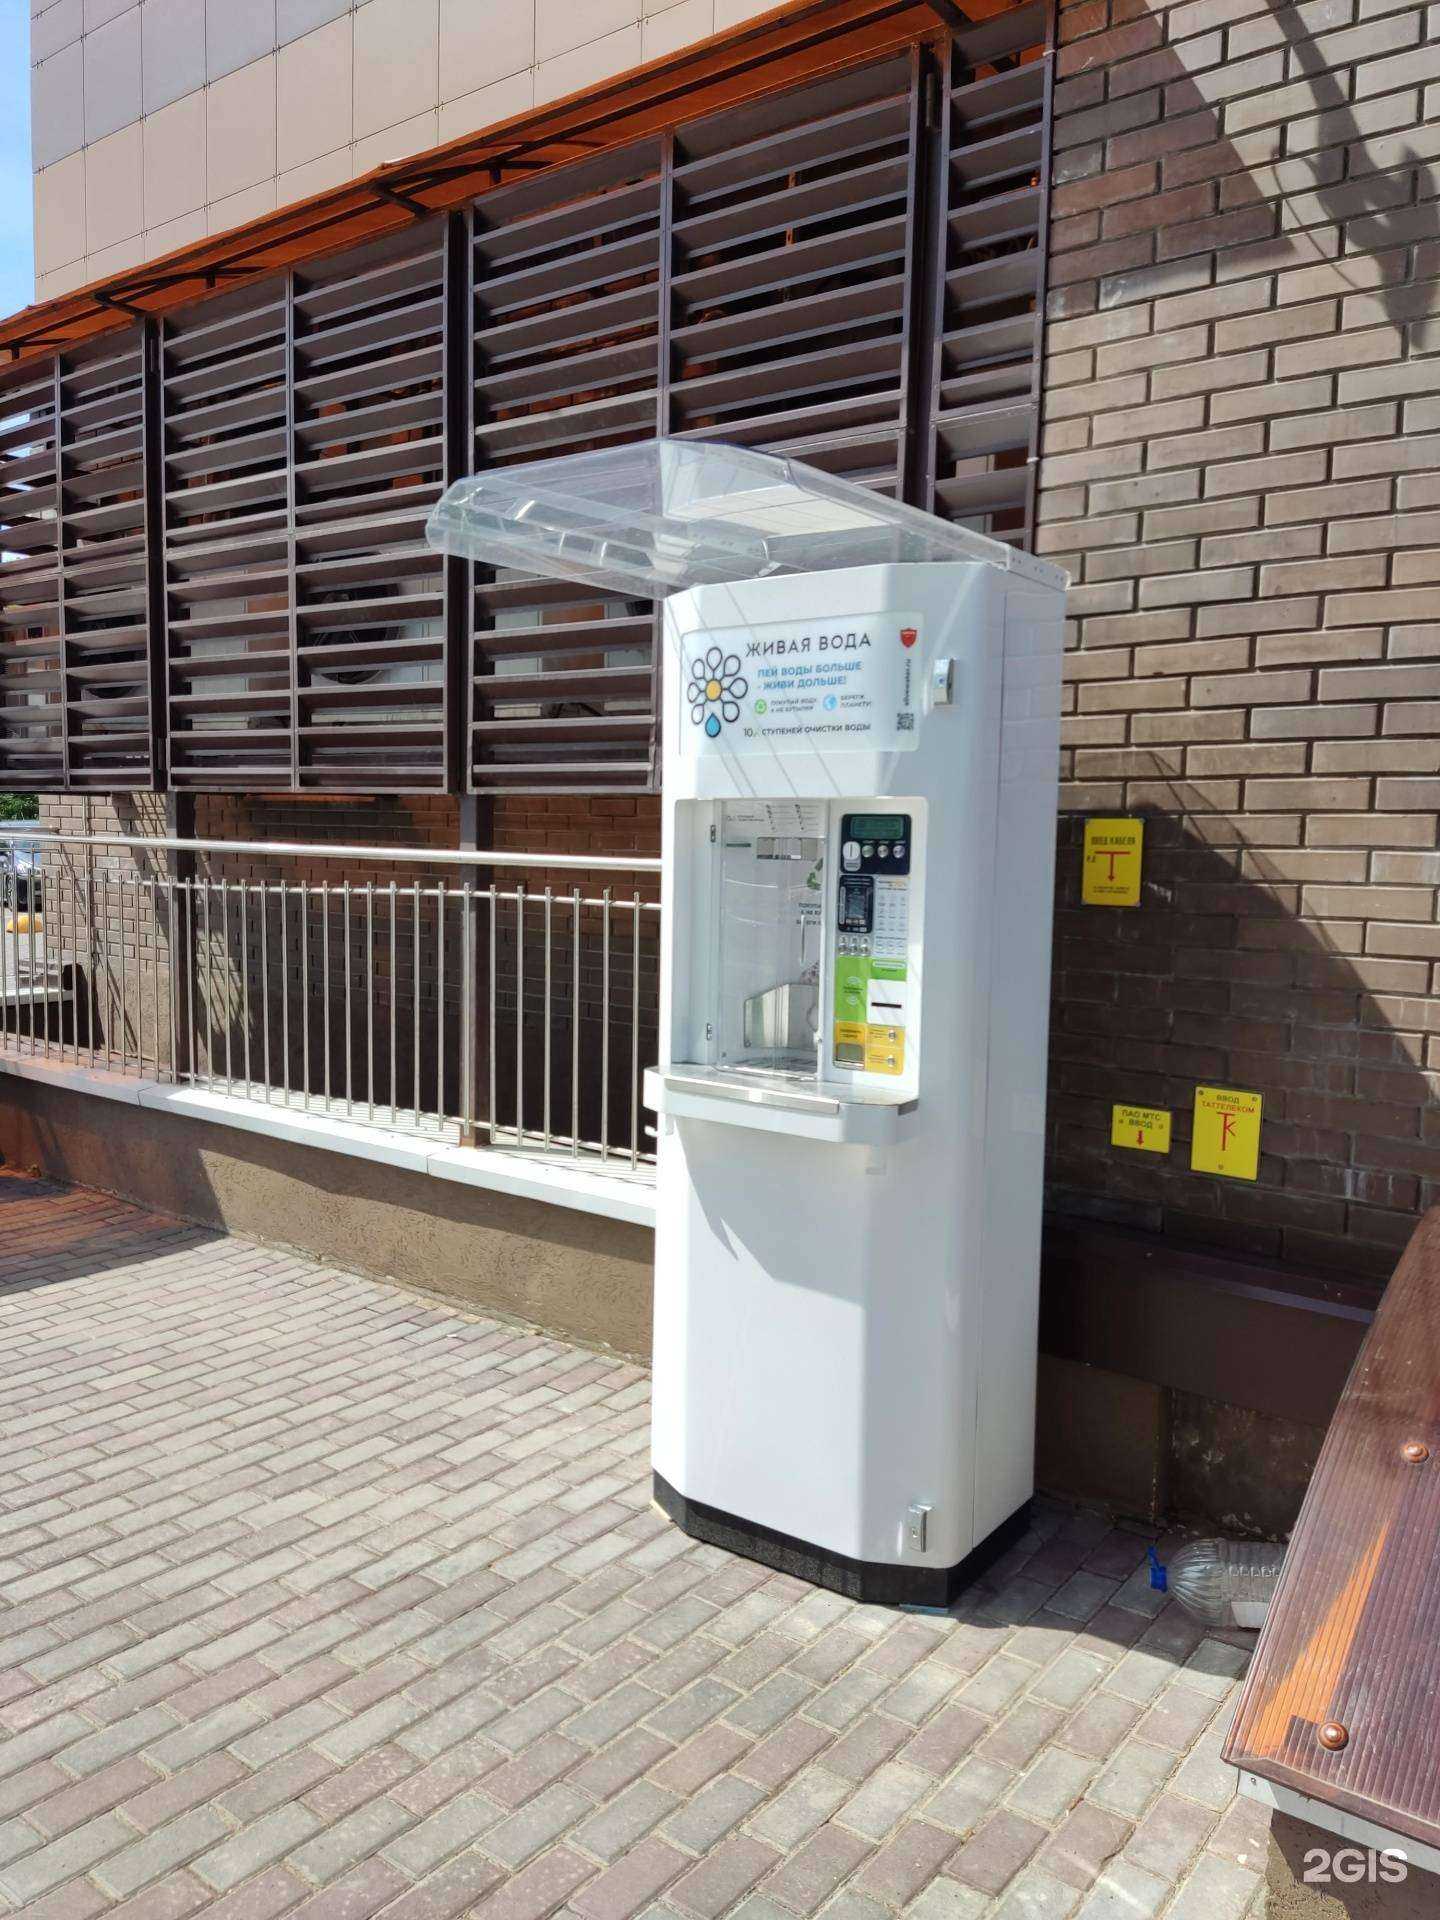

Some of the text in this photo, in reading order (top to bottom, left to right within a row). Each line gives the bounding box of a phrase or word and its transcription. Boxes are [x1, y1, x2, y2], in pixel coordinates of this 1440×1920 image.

[746, 633, 871, 657] ЖИВАЯ ВОДА
[781, 665, 813, 677] ВОДЫ
[815, 660, 863, 674] БОЛЬШЕ
[763, 679, 795, 690] ЖИВИ
[744, 723, 871, 738] 10 СТУПЕНЕЙ ОЧИСТКИ ВОДЫ
[1216, 1094, 1240, 1105] ВВОД
[1142, 1112, 1161, 1121] МТС
[1128, 1118, 1153, 1130] ВВОД
